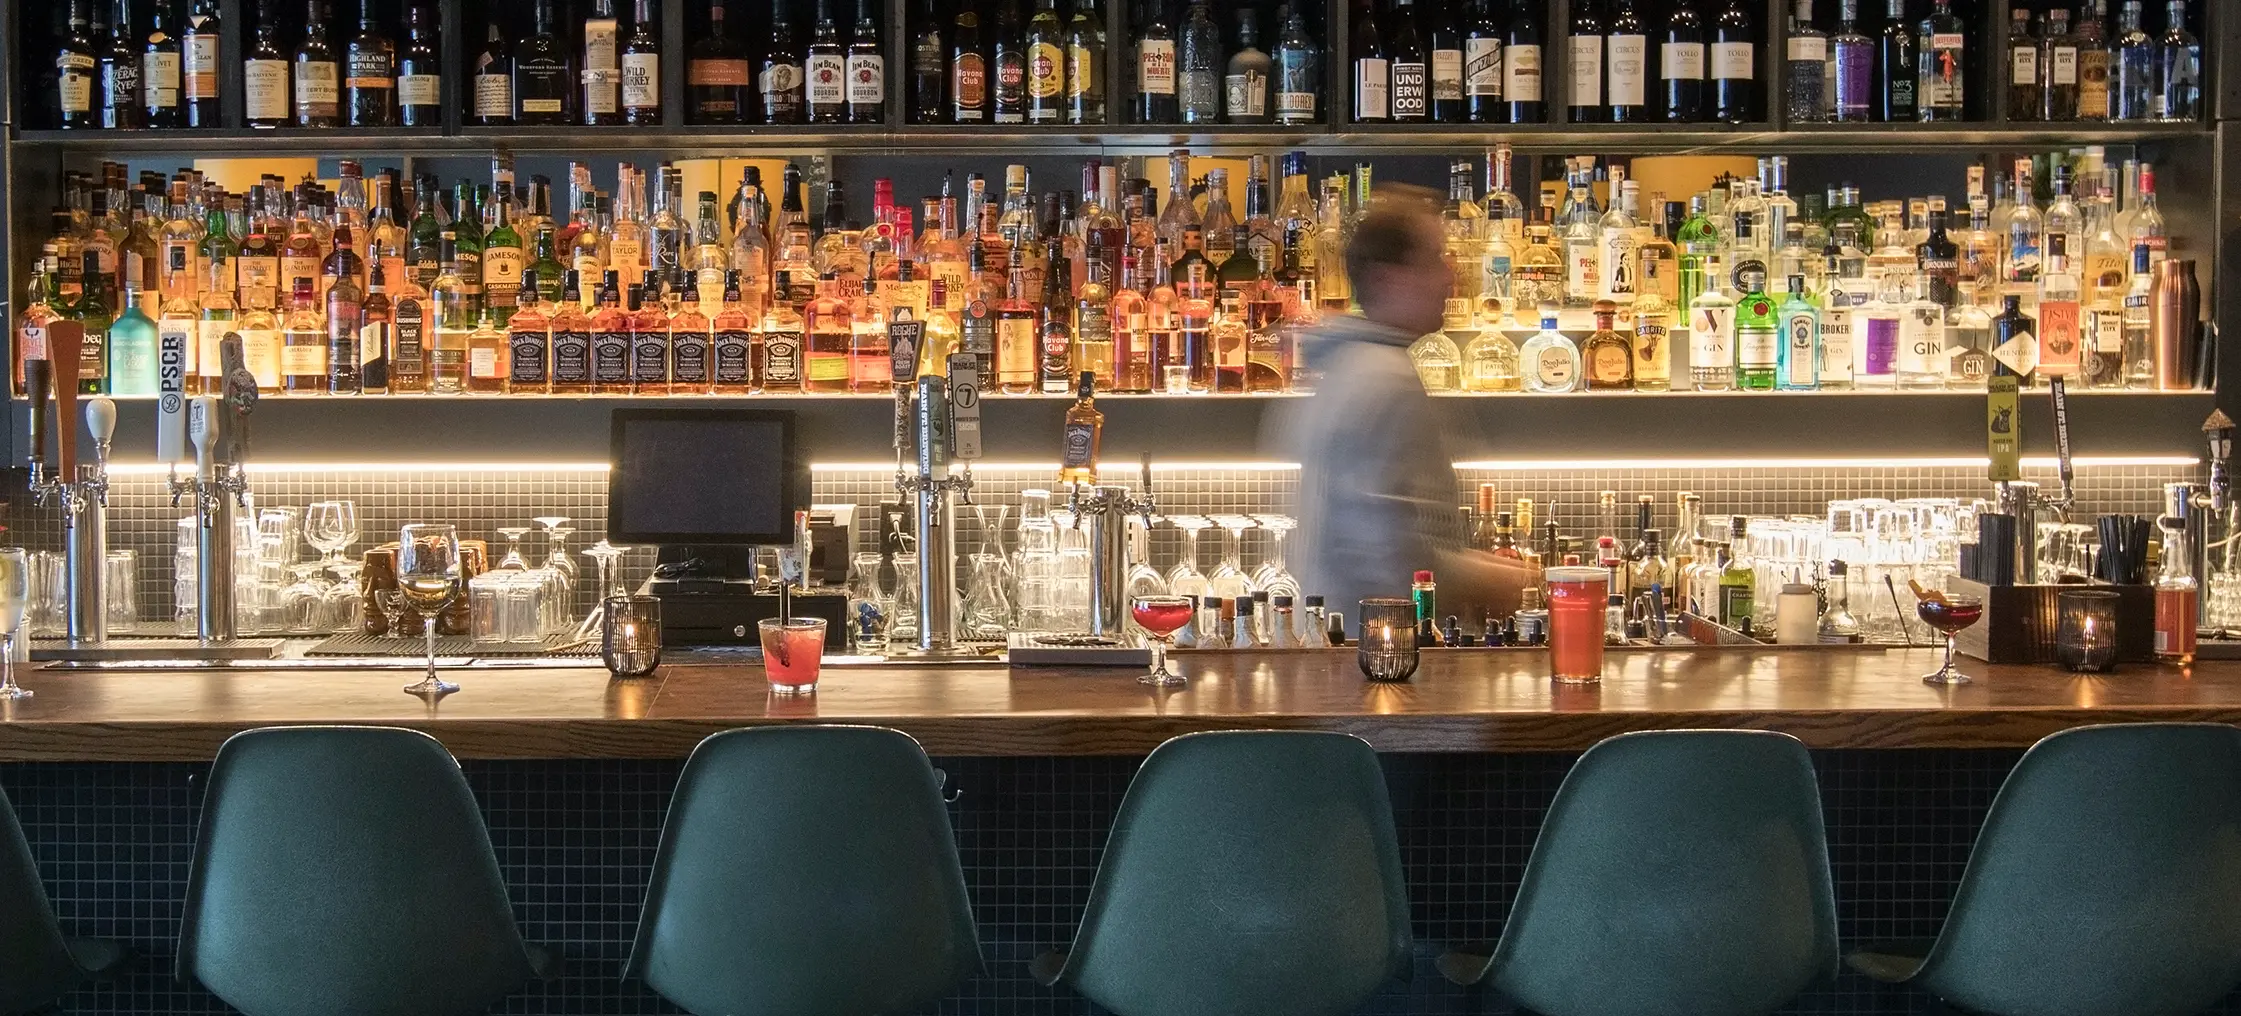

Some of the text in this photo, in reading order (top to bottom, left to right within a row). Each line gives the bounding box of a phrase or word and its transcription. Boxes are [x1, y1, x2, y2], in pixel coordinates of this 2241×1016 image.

[349, 54, 386, 63] HIGHLAND
[357, 62, 377, 70] PARK
[626, 66, 646, 76] WILD
[811, 60, 842, 73] JIM BEAM
[851, 60, 881, 73] JIM BEAM
[962, 75, 978, 85] Club
[1002, 73, 1019, 83] Club
[1396, 74, 1422, 85] UND
[1396, 86, 1422, 97] ERW
[1396, 98, 1422, 109] OOD
[611, 247, 638, 255] TAYLOR
[454, 253, 479, 263] MESON
[486, 252, 521, 262] JAMESON
[940, 273, 961, 283] WILD
[944, 283, 965, 292] RKEY
[2126, 295, 2149, 307] SMIR
[892, 324, 918, 337] ROGUE
[512, 337, 525, 349] JACK
[555, 337, 567, 349] JACK
[595, 337, 608, 349] JACK
[634, 337, 648, 349] JACK
[674, 337, 687, 349] JACK
[715, 337, 729, 349] JACK
[766, 337, 778, 349] JACK
[1047, 343, 1063, 352] Club
[1704, 344, 1724, 352] GIN
[1913, 342, 1942, 355] GIN
[161, 336, 178, 392] PSCB
[1963, 359, 1985, 374] GIN
[964, 388, 971, 406] 7
[1997, 444, 2009, 453] IPA
